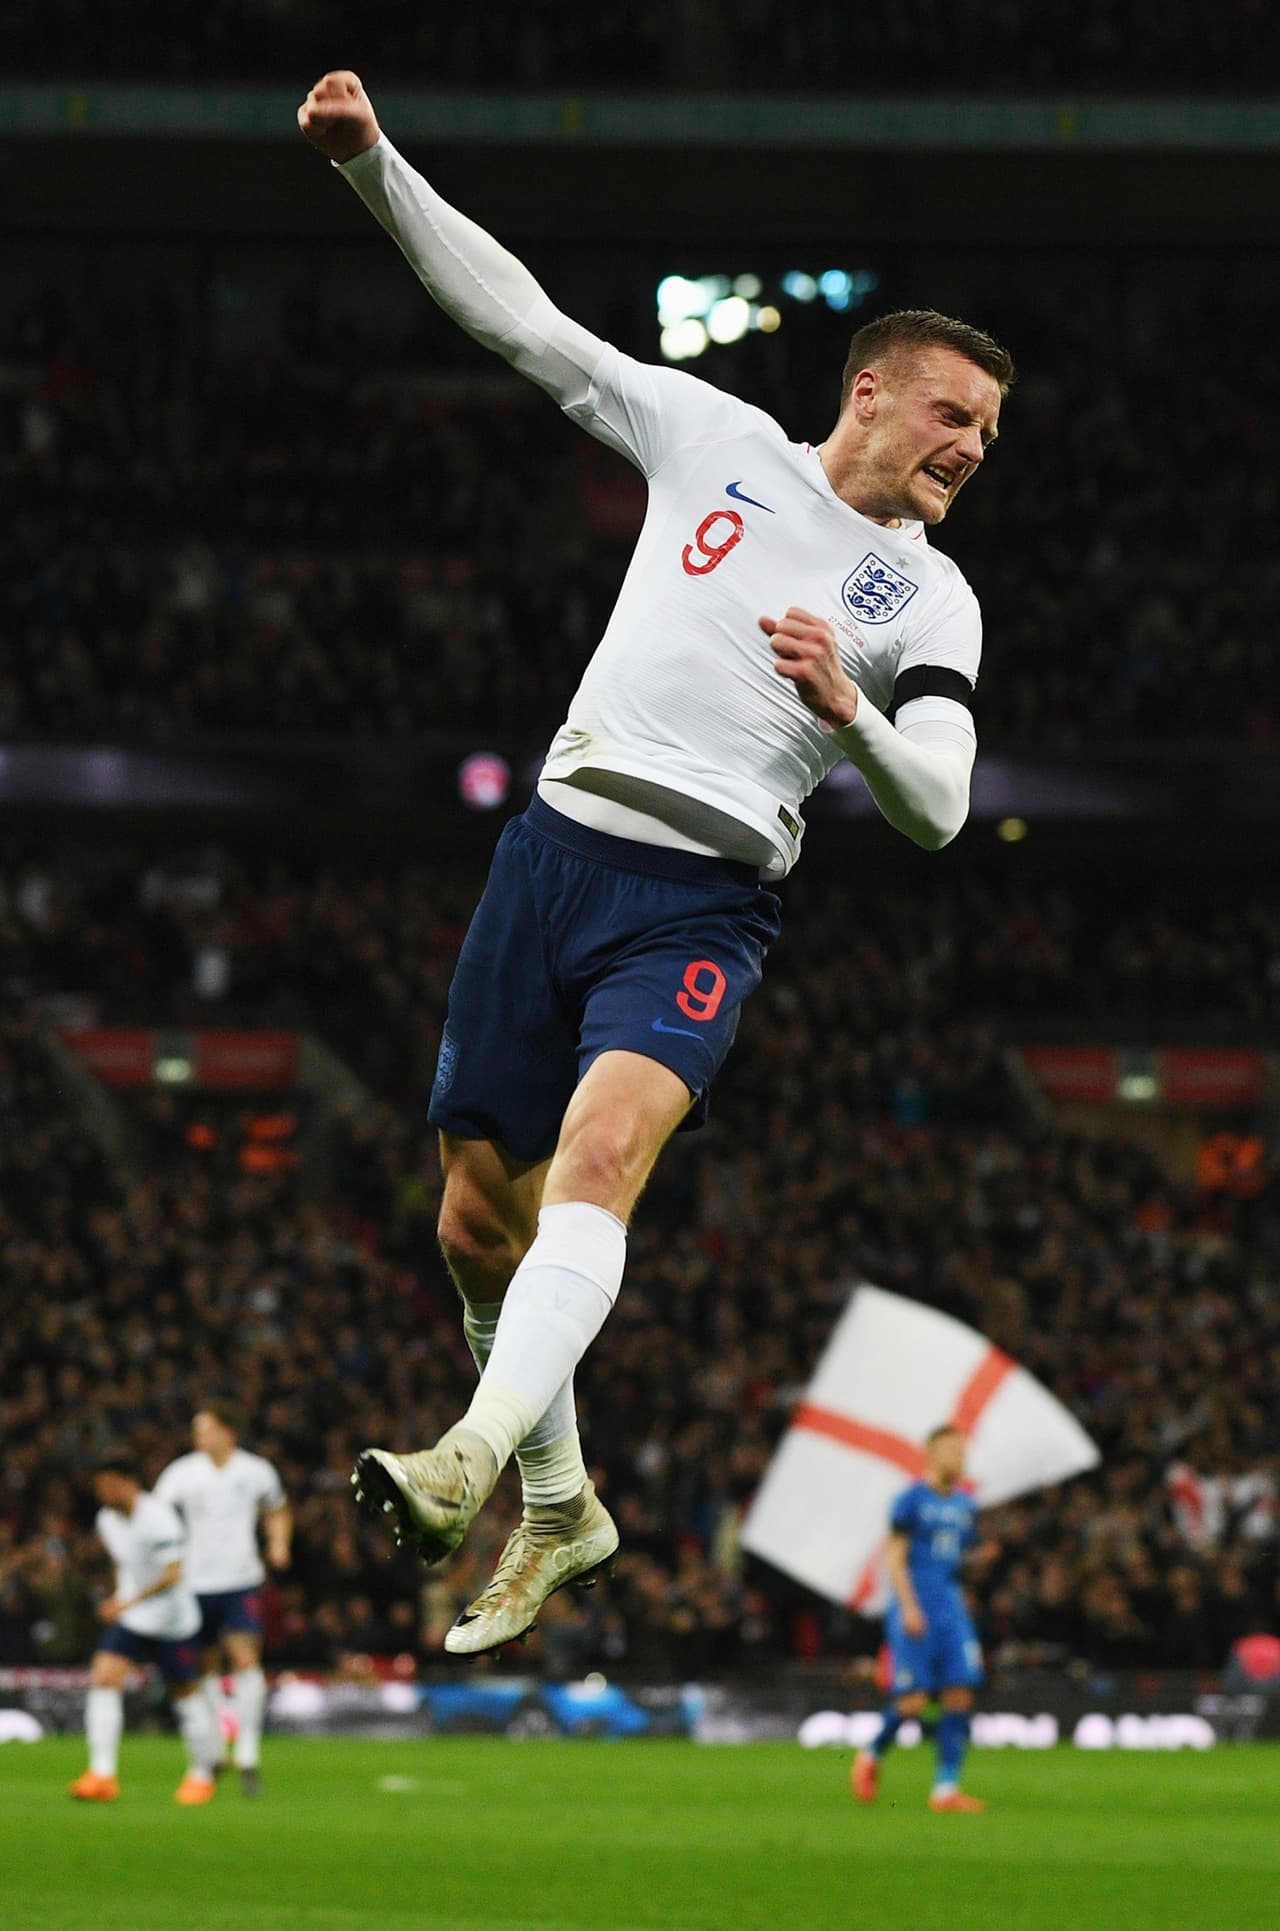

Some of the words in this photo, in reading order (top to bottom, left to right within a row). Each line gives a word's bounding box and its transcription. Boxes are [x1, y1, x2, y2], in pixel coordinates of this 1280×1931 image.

[682, 510, 744, 576] 9
[836, 621, 855, 638] MARCH
[676, 960, 727, 1021] 9
